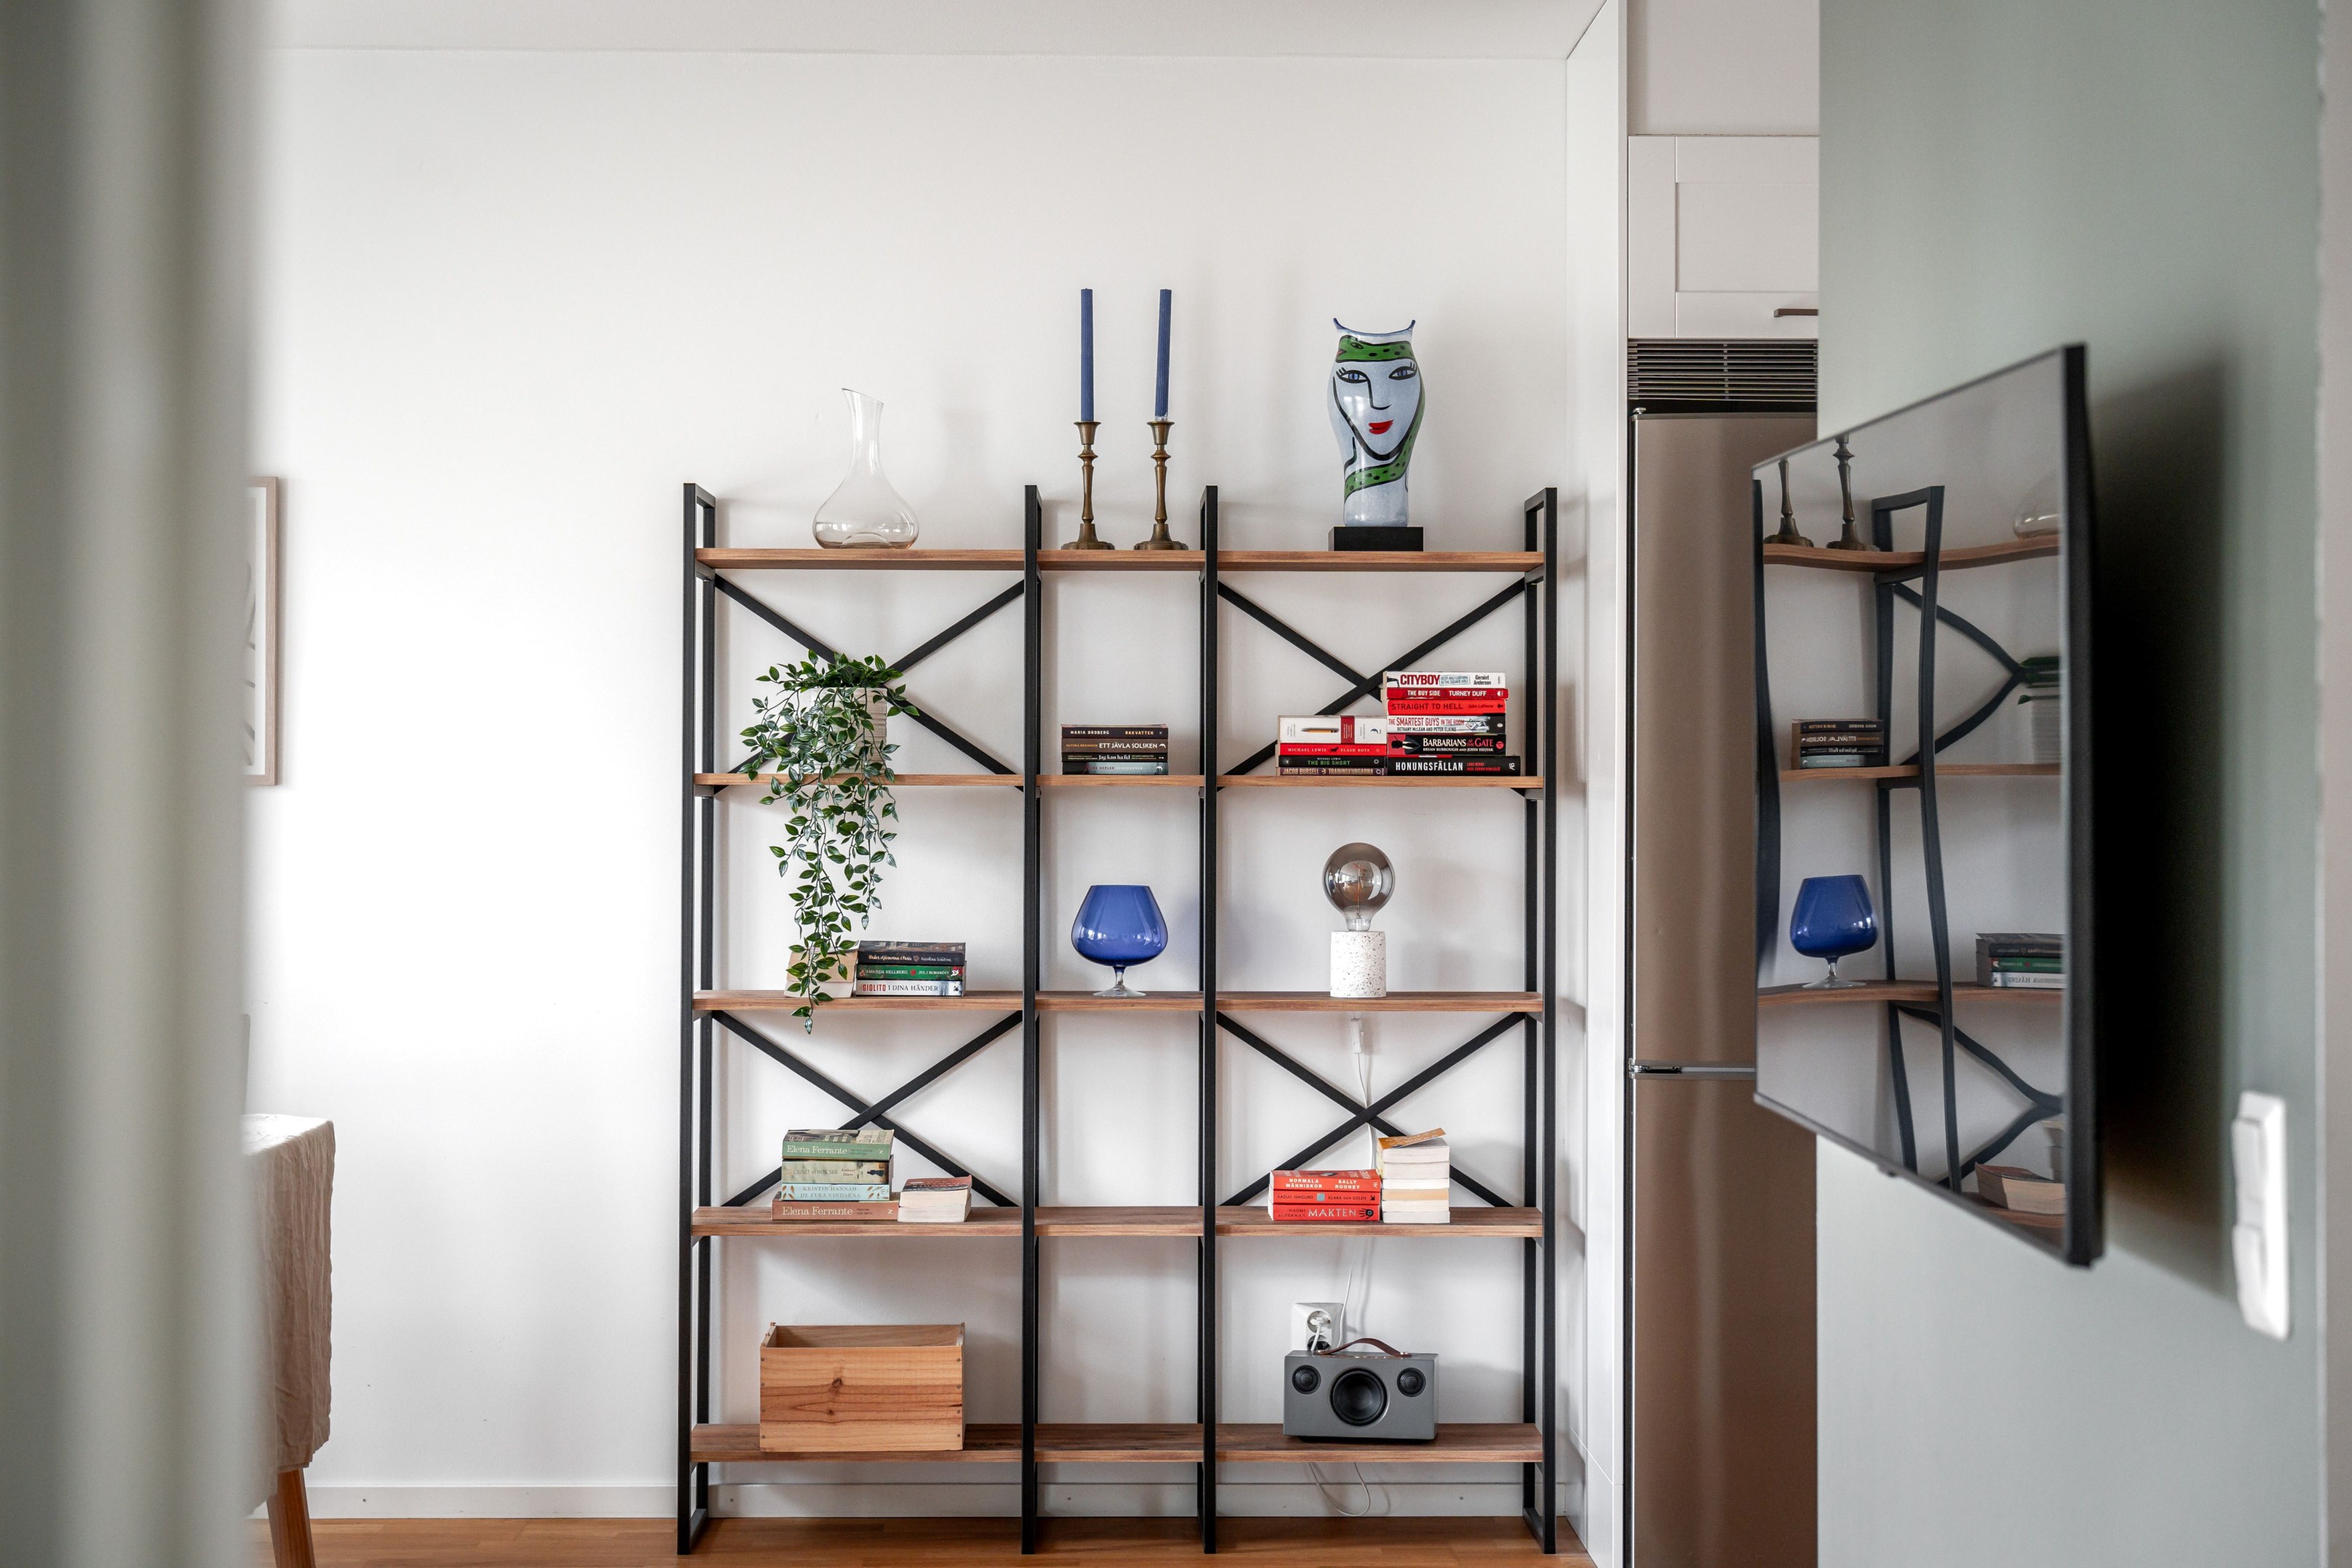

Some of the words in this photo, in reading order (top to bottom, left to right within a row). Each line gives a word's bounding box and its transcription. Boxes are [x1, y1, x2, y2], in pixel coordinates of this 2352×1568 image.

[1400, 674, 1440, 685] CITYBOY
[1397, 717, 1424, 726] SMARTEST
[1426, 717, 1440, 726] GUYS
[1423, 738, 1466, 747] BARBARIANS
[1475, 738, 1493, 747] GATE
[1395, 761, 1463, 771] HONUNGSFÄLLAN
[812, 1146, 848, 1154] Ferrante
[782, 1206, 809, 1215] Elena
[812, 1206, 853, 1215] Ferrante
[1308, 1208, 1356, 1217] MAKTEN
